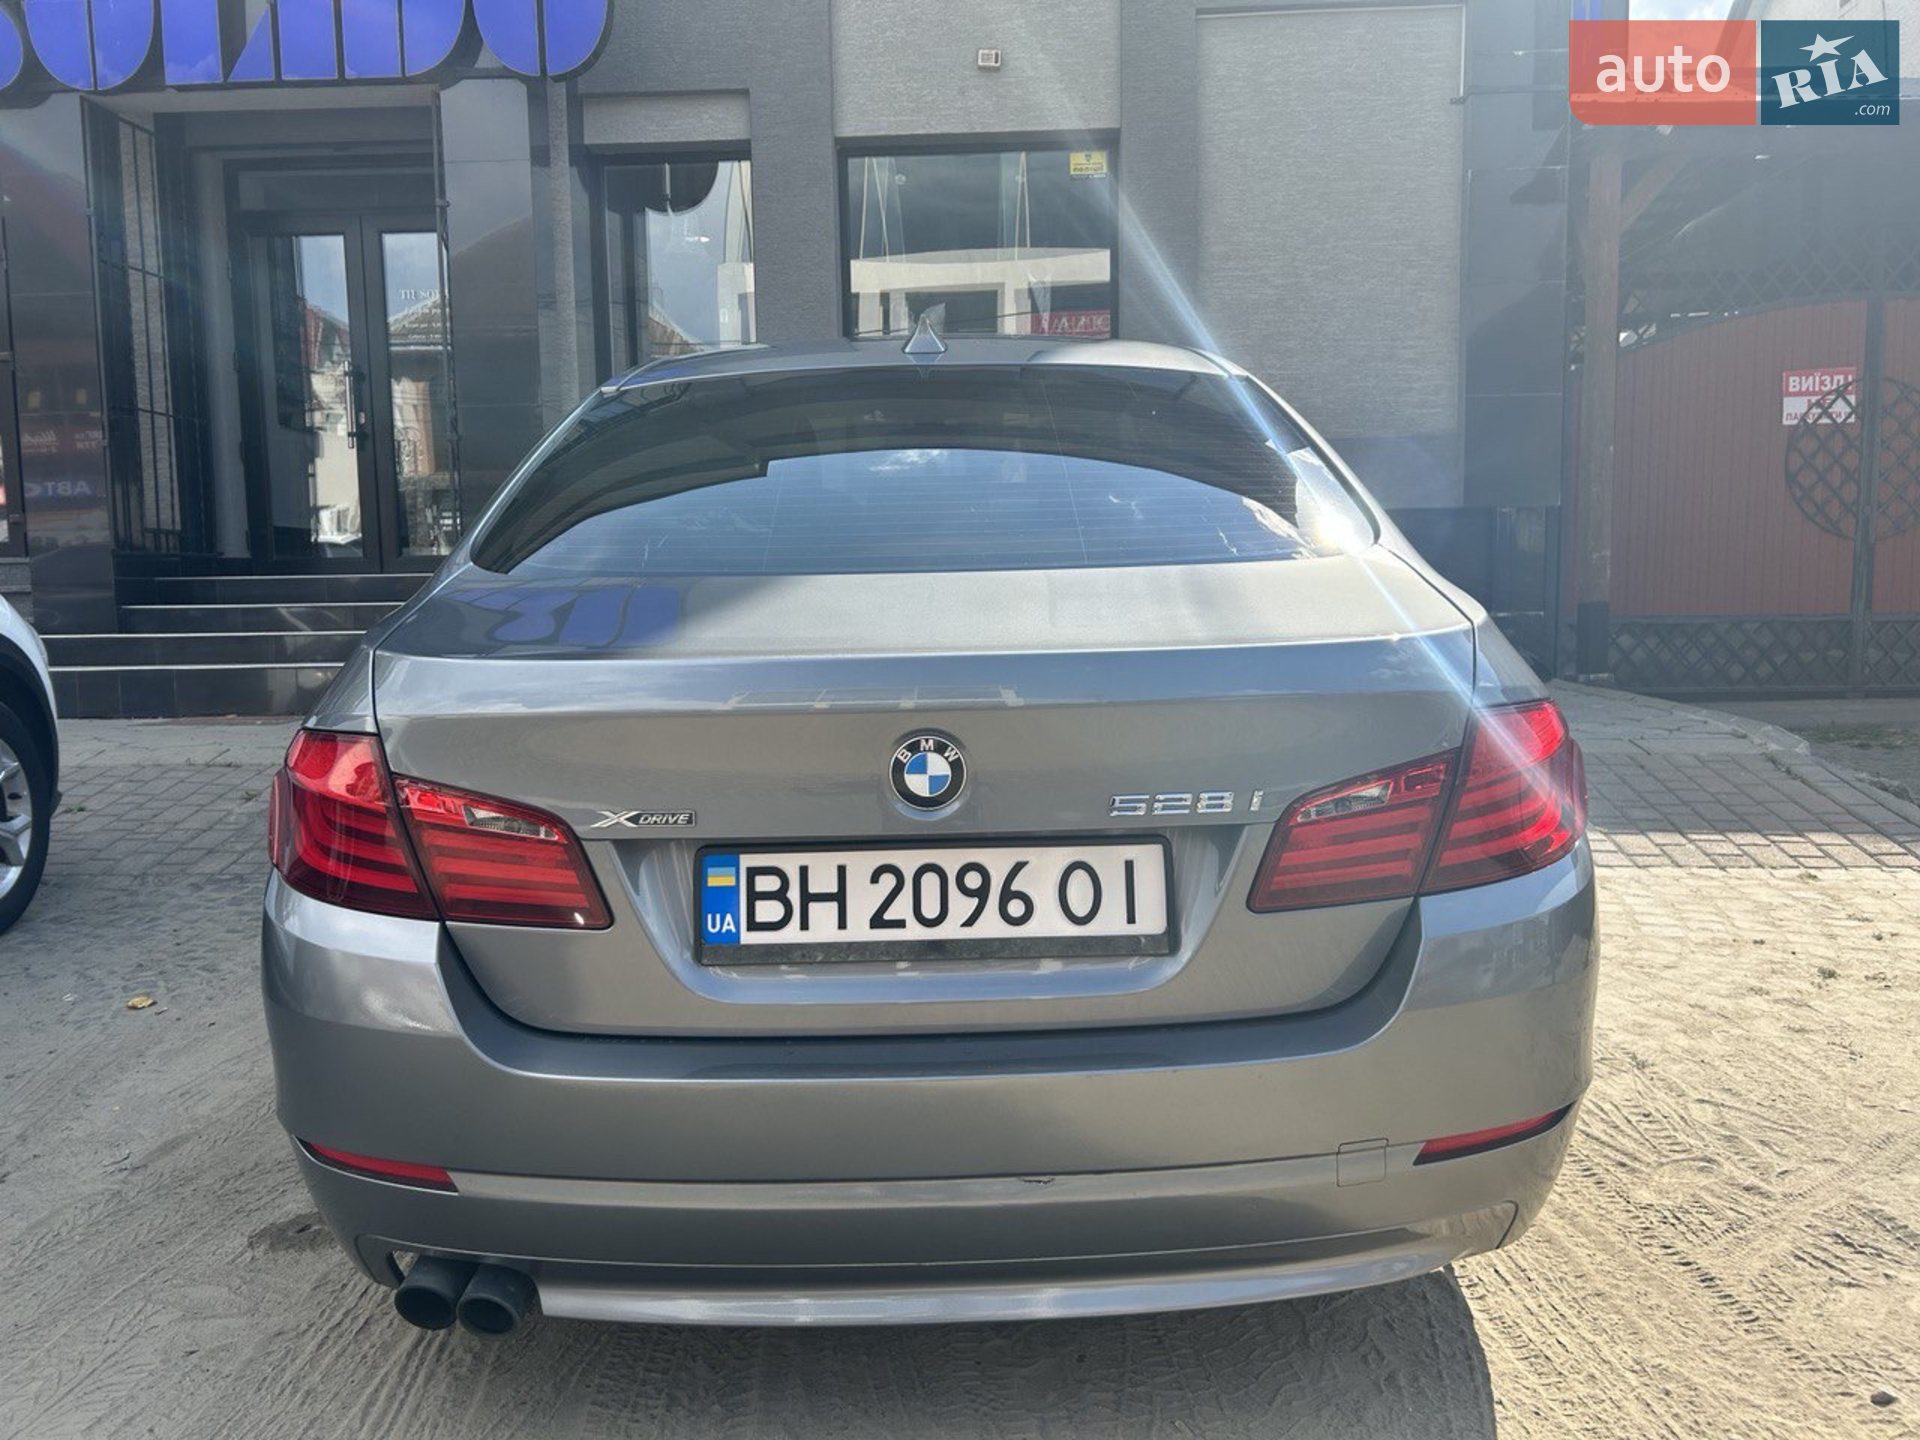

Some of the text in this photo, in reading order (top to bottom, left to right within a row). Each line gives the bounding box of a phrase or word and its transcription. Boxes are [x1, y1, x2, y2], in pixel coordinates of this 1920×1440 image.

[896, 738, 960, 763] BMW
[869, 860, 1034, 929] 2096
[707, 913, 736, 933] UA
